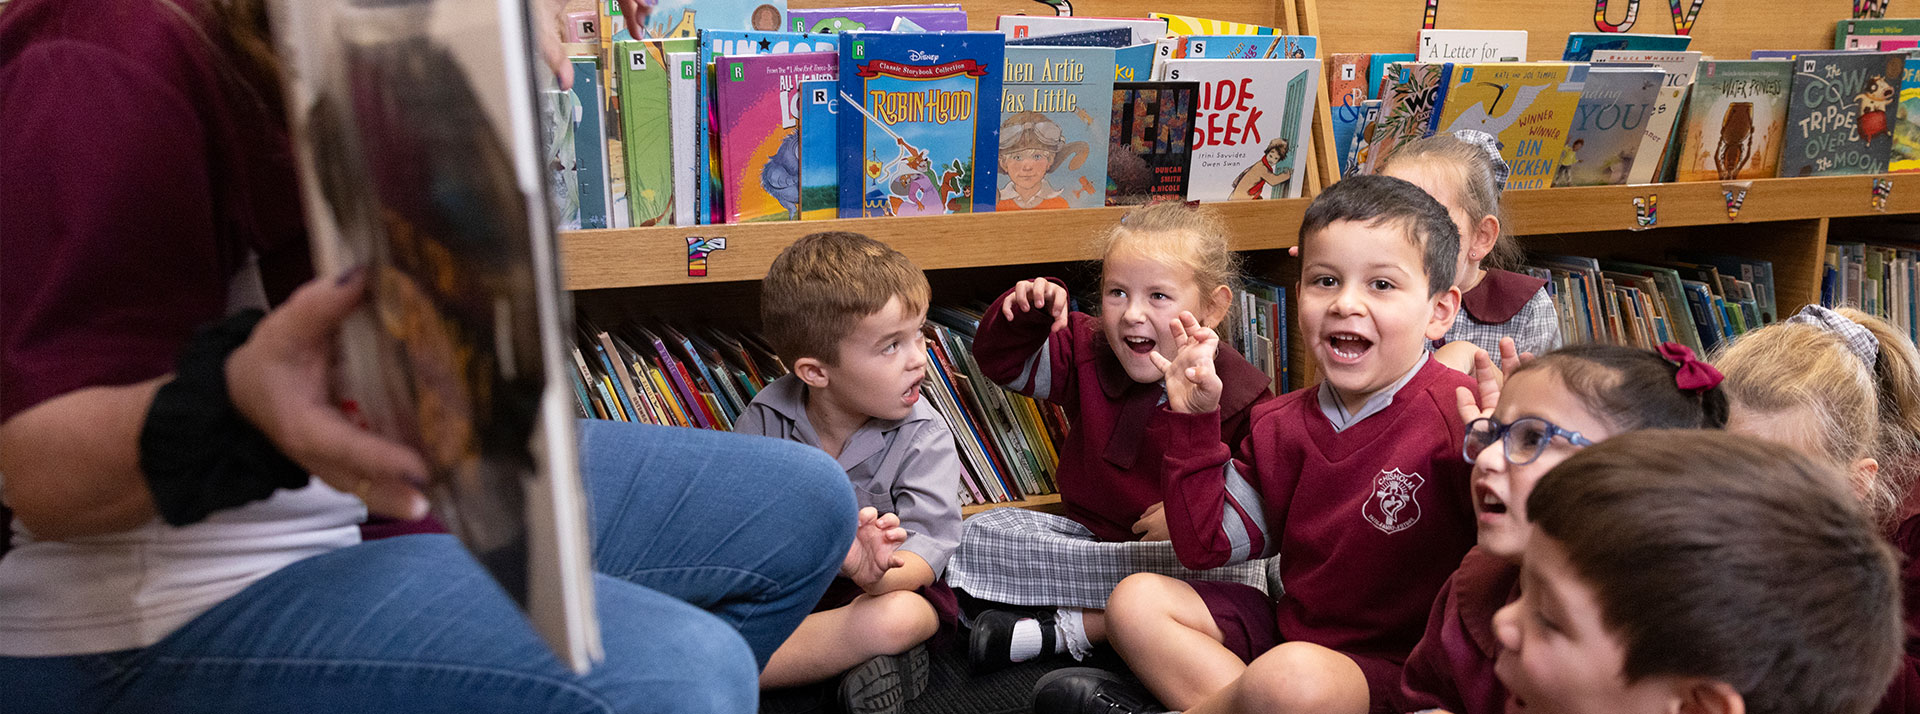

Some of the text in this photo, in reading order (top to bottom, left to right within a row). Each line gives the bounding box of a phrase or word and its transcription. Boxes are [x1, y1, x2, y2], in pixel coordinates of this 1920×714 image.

[612, 0, 620, 12] R
[583, 22, 594, 33] R
[1195, 43, 1203, 54] S
[1424, 37, 1430, 46] T
[856, 44, 864, 56] R
[908, 49, 939, 64] Disney
[1161, 46, 1168, 56] S
[1429, 42, 1498, 62] A Letter for
[634, 54, 644, 64] R
[686, 65, 692, 76] R
[735, 67, 742, 78] R
[880, 62, 965, 77] Classic Storybook Collection
[1003, 57, 1084, 82] hen Artie
[1346, 68, 1352, 78] T
[1806, 62, 1814, 71] W
[1171, 70, 1179, 80] S
[780, 74, 794, 92] ALL
[1804, 68, 1867, 108] COW
[815, 91, 824, 102] R
[1000, 88, 1077, 113] as Little
[1198, 78, 1254, 112] IDE
[870, 89, 972, 126] ROBIN HOOD
[1370, 110, 1376, 120] T
[1519, 110, 1554, 128] WINNER
[1576, 103, 1649, 132] YOU
[1529, 126, 1560, 140] WINNER
[1516, 140, 1543, 158] BIN
[1805, 132, 1847, 160] OVER
[1833, 151, 1883, 175] MOON
[1378, 473, 1415, 491] CHISHOLM
